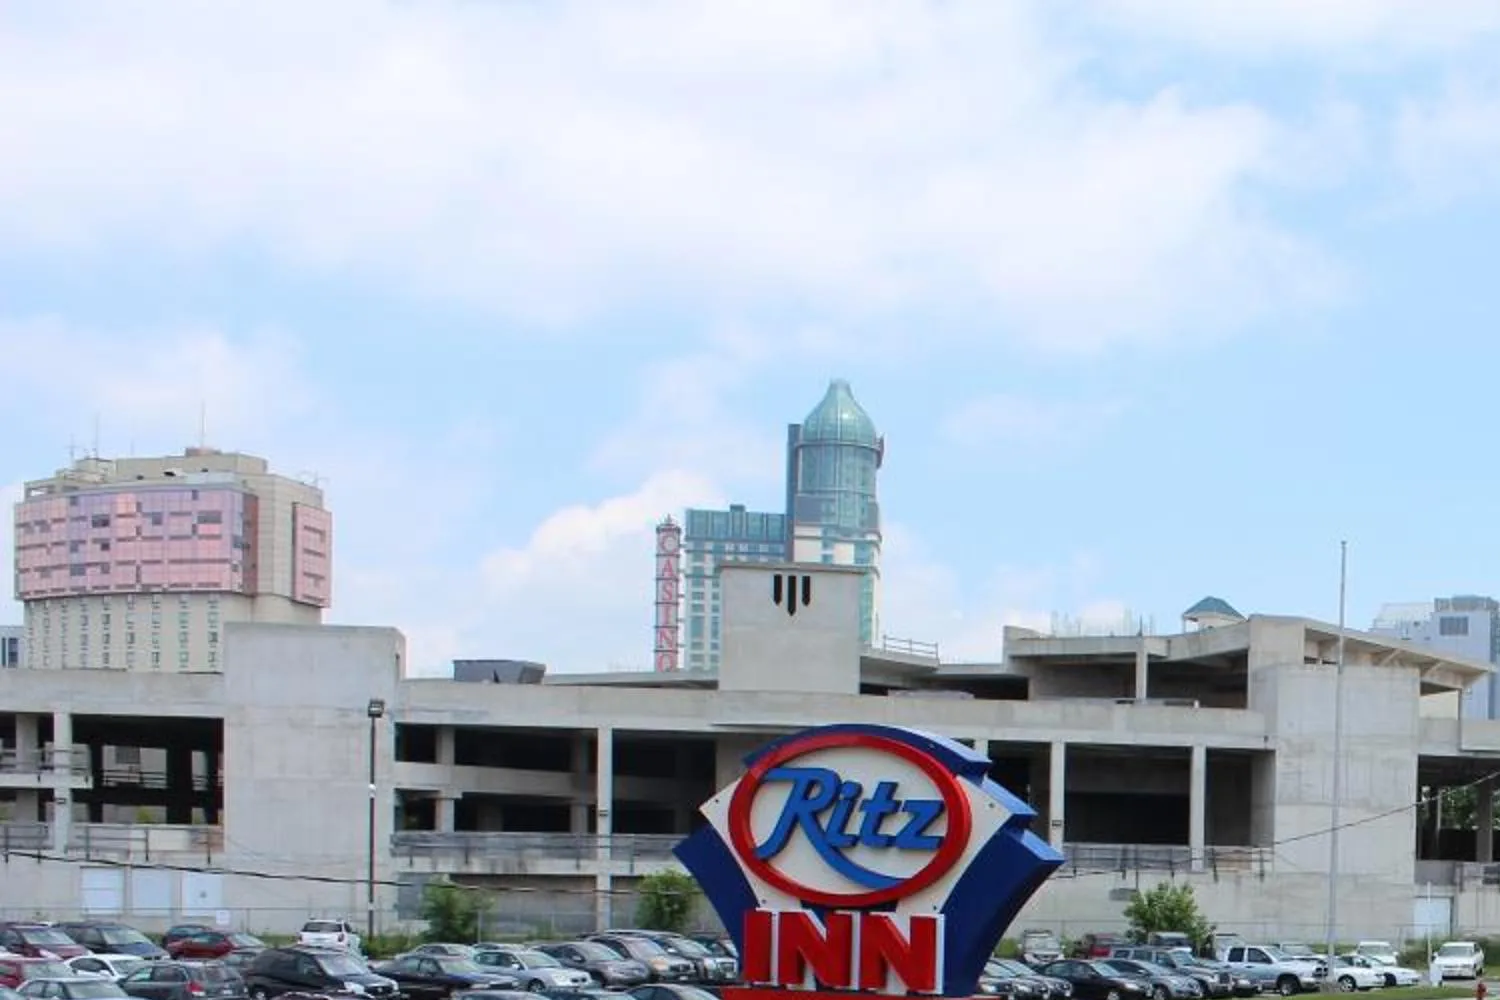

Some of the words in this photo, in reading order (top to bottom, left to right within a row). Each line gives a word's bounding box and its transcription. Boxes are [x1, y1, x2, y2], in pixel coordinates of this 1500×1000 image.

[658, 535, 674, 672] CASINO
[754, 767, 945, 889] Ritz
[744, 908, 943, 994] INN
